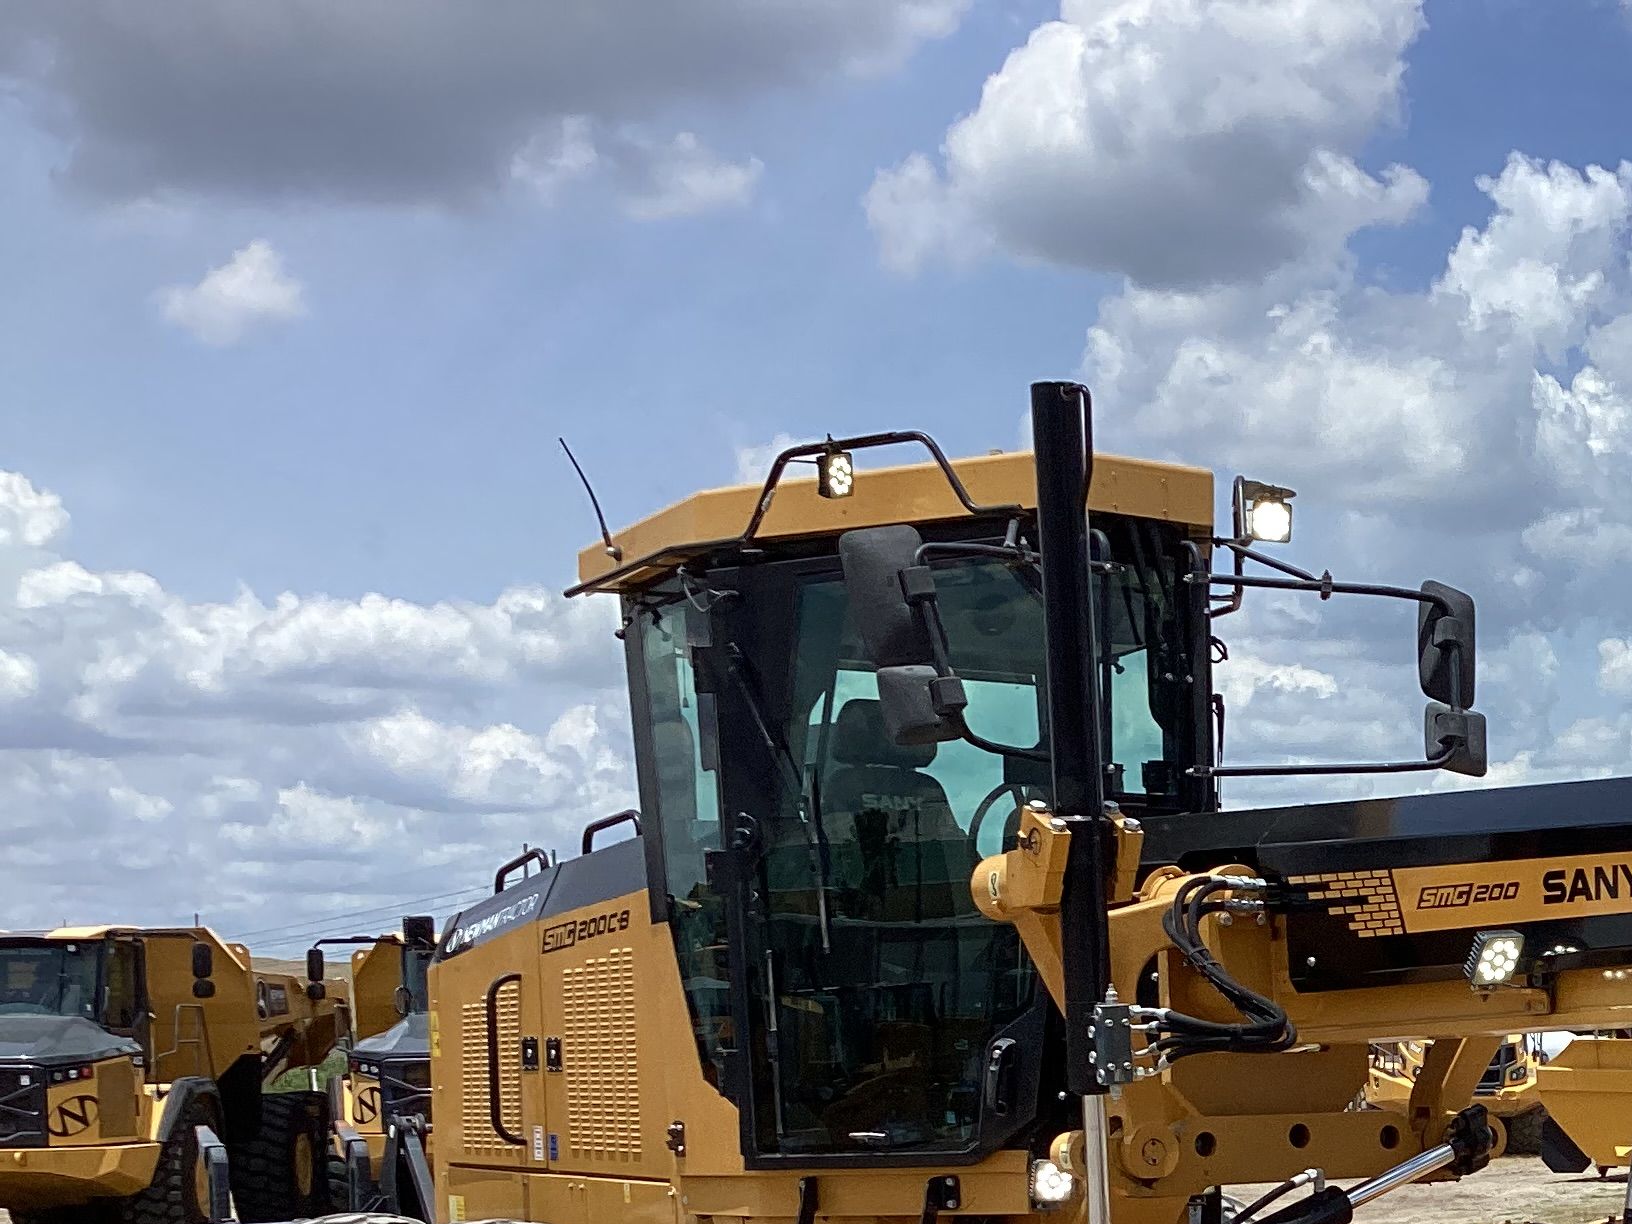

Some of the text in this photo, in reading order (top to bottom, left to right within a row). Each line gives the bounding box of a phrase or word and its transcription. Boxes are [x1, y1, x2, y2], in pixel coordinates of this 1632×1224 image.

[1418, 884, 1472, 909] SMG
[1473, 882, 1520, 902] 200
[577, 910, 630, 941] 200C-8
